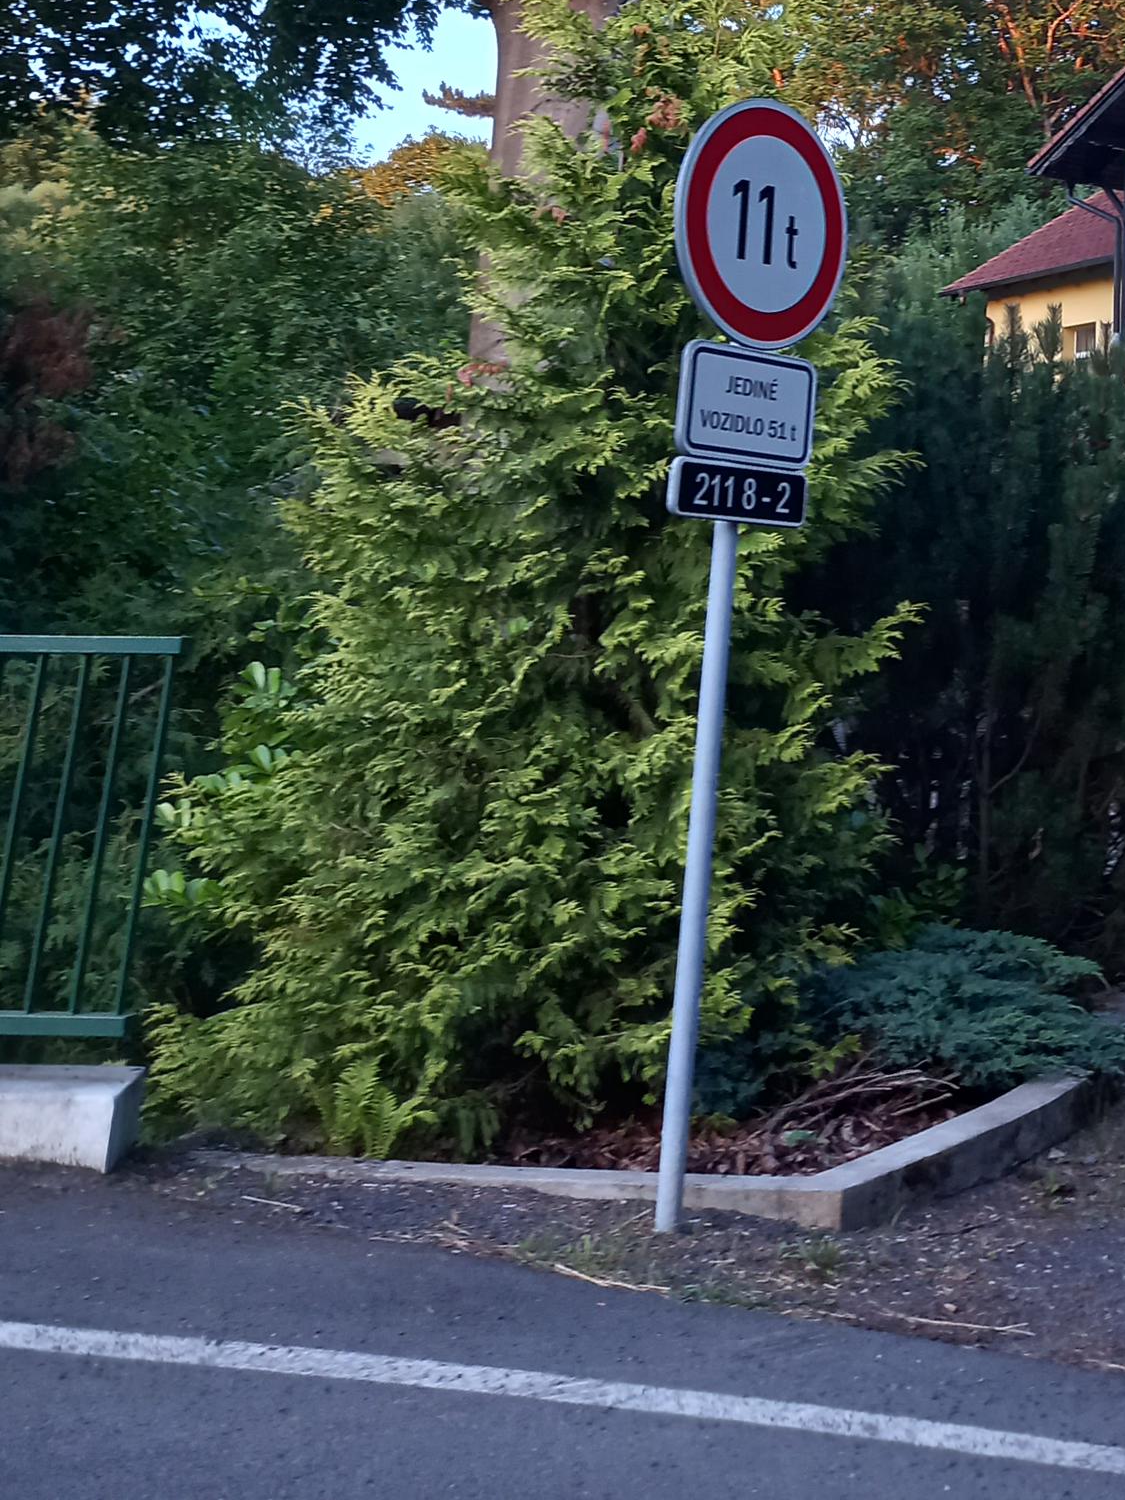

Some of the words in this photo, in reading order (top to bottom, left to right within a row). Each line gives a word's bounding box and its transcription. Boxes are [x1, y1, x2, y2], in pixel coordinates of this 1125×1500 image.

[725, 376, 778, 401] JEDINÉ
[700, 409, 764, 436] VOZIDLO
[767, 420, 787, 440] 51
[693, 472, 791, 514] 2118-2
